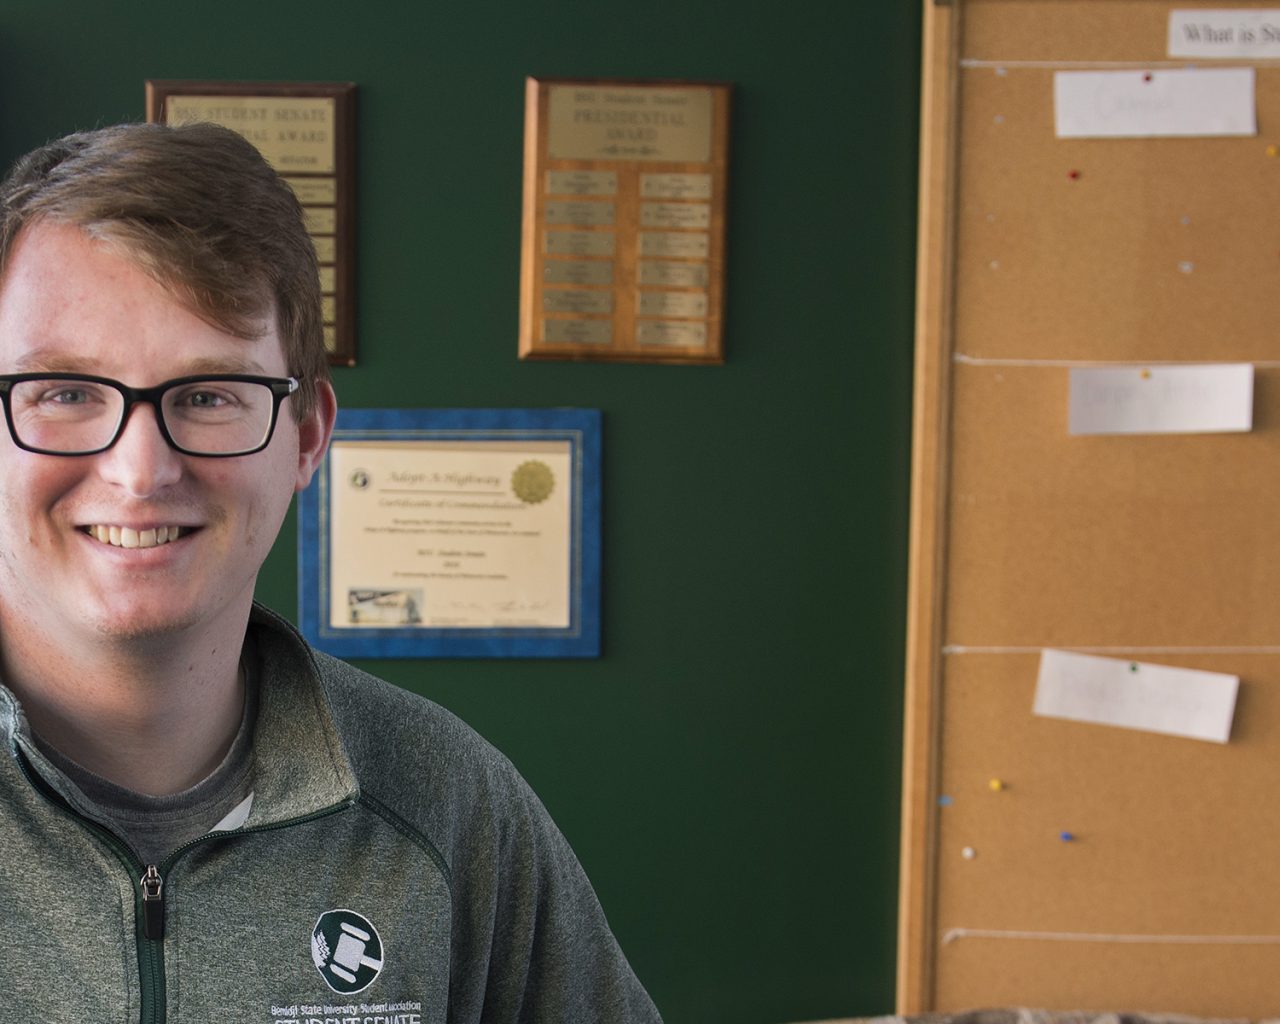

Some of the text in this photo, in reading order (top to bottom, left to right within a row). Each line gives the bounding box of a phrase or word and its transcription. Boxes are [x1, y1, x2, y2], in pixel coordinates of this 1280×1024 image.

[1183, 23, 1234, 42] What
[1240, 22, 1256, 42] is
[300, 1005, 322, 1016] State
[323, 1003, 358, 1016] University
[360, 1002, 388, 1014] Student
